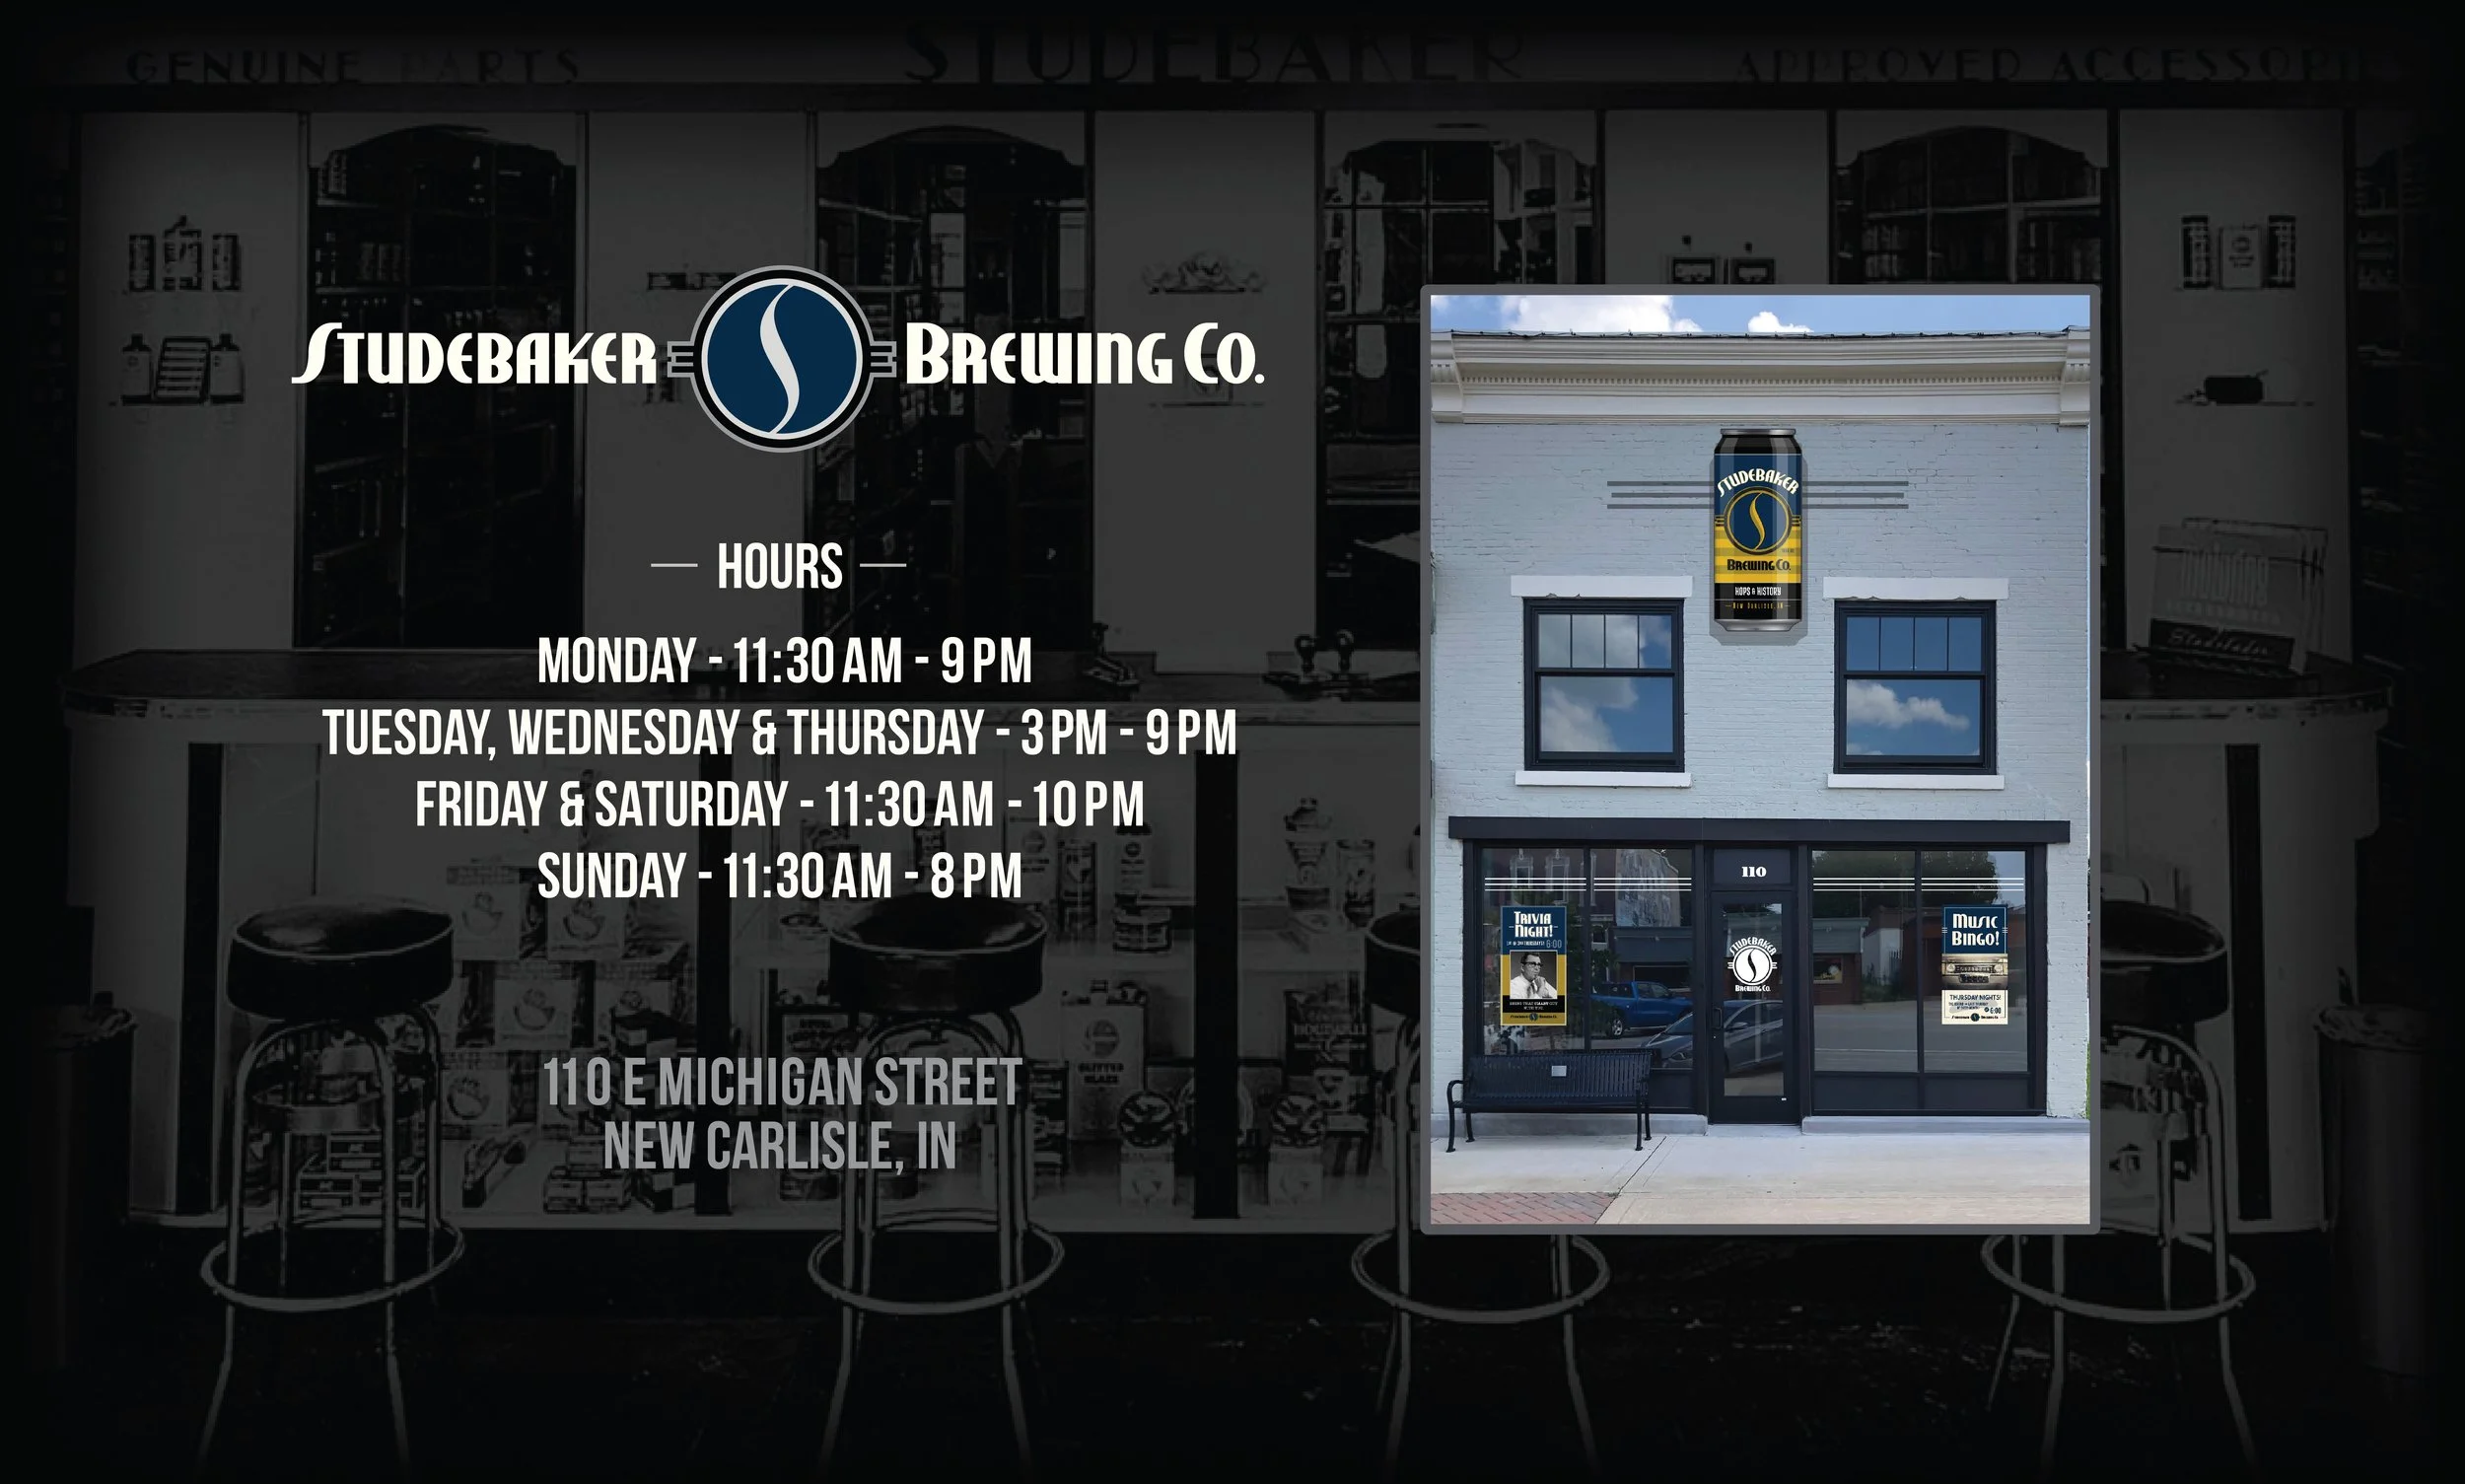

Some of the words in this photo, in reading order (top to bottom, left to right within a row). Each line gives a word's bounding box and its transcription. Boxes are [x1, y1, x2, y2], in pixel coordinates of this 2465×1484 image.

[904, 19, 1524, 83] STUDEBAKER
[1741, 866, 1767, 878] 110
[1514, 911, 1552, 925] TRIVIA
[1952, 913, 1999, 929] MUSIC
[1514, 924, 1554, 938] NIGHT!
[1951, 930, 2000, 946] BINGO!
[1546, 939, 1563, 949] 6:00
